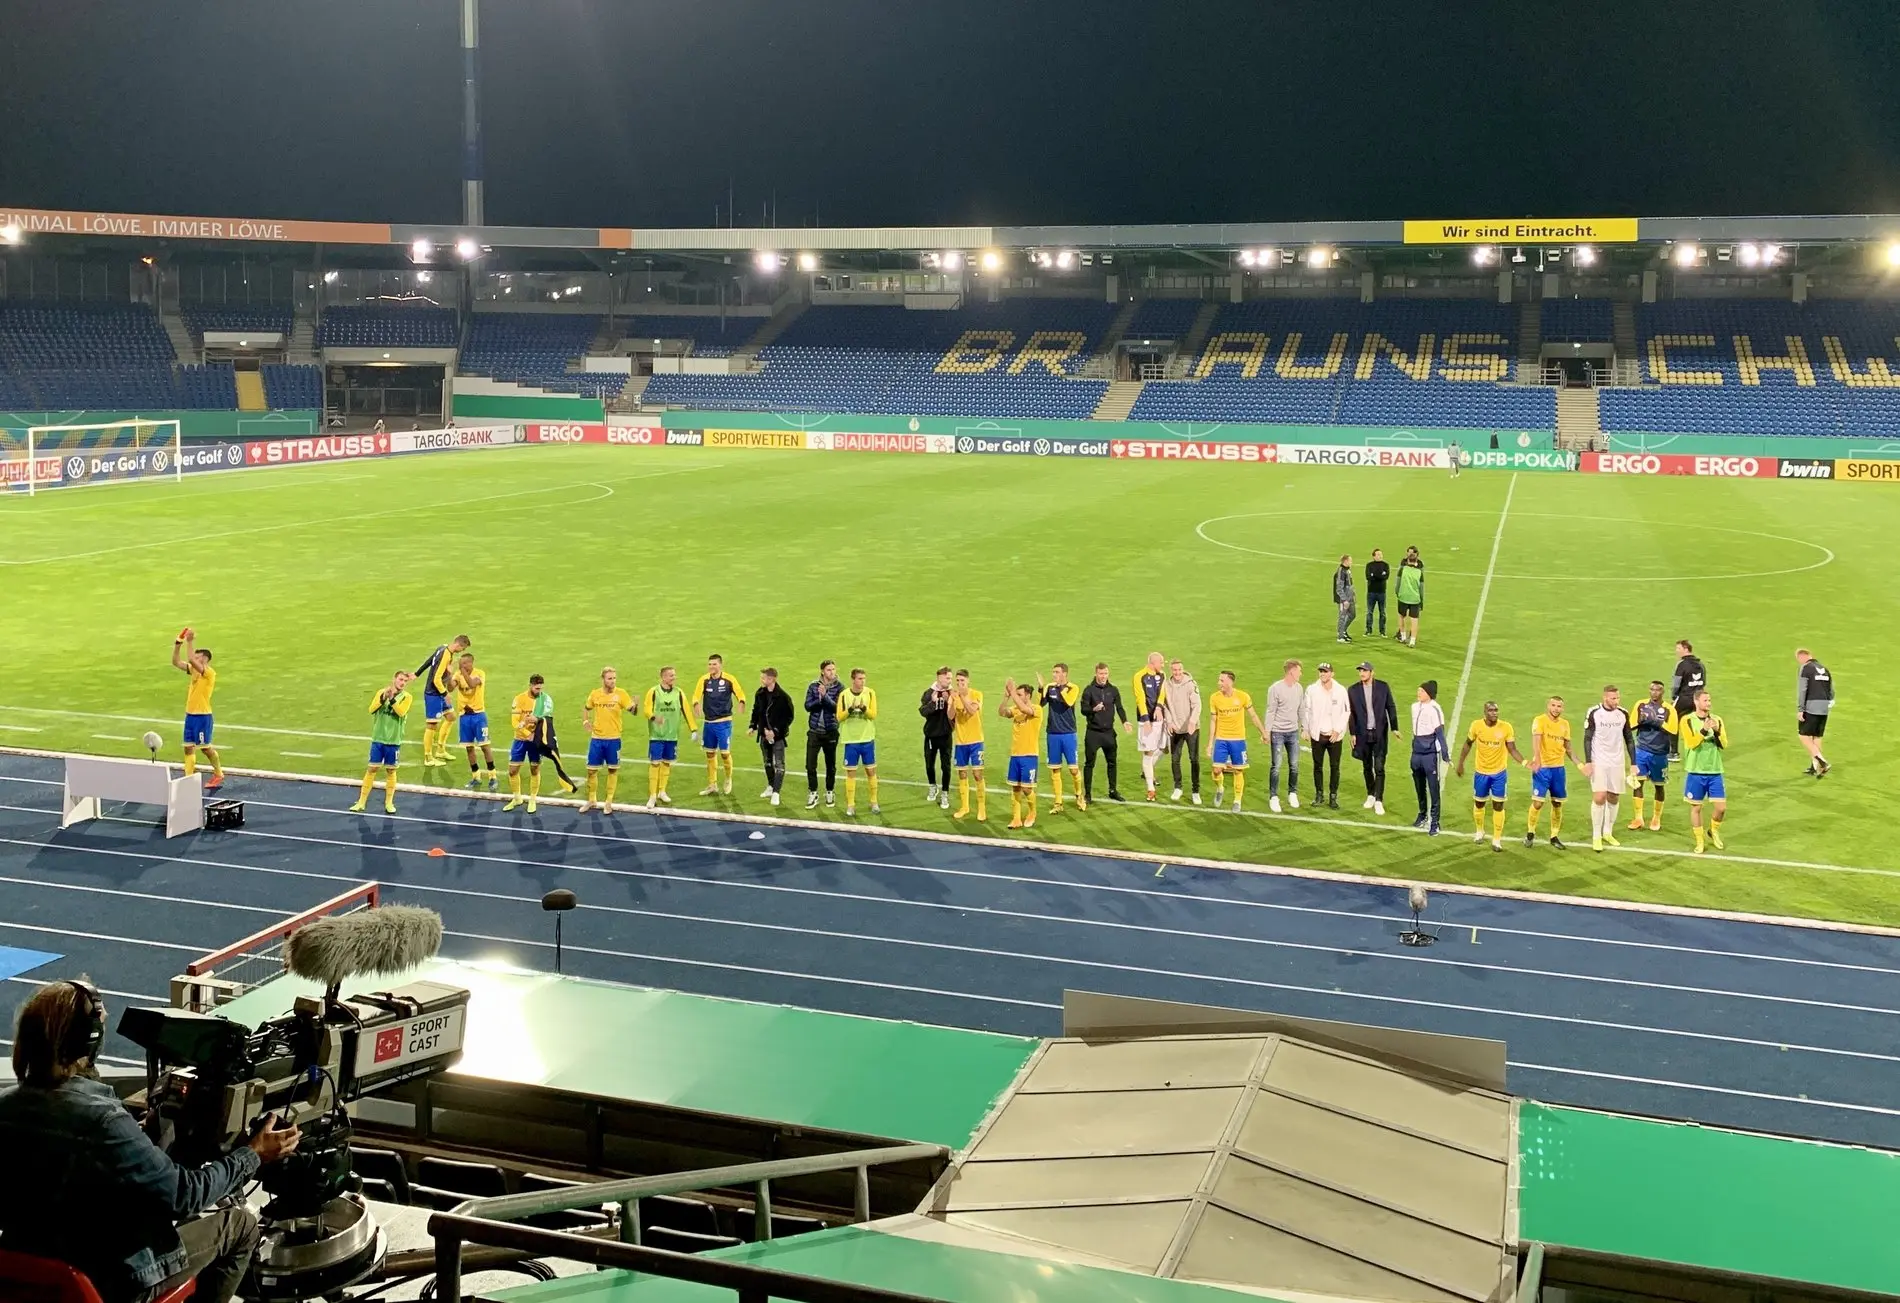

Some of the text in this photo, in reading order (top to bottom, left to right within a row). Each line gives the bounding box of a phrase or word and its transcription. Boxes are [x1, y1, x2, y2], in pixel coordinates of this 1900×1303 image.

[83, 214, 146, 234] LÖWE.
[152, 219, 222, 237] IMMER
[229, 220, 287, 239] LÖWE.
[1443, 225, 1597, 238] Wir sind Eintracht.
[539, 426, 652, 444] ERGO ERGO
[666, 430, 799, 447] bwin SPORTWETTEN
[833, 434, 927, 450] BAUHAUS
[266, 436, 375, 462] STRAUSS
[977, 440, 1000, 452] Der
[1003, 440, 1031, 453] Golf
[1053, 442, 1076, 455] Der
[1079, 442, 1108, 455] Golf
[1127, 442, 1260, 461] STRAUSS
[91, 459, 115, 473] Der
[117, 455, 146, 472] Golf
[197, 450, 222, 464] Golf
[1599, 455, 1661, 473] ERGO
[1695, 457, 1759, 476] ERGO
[1780, 461, 1831, 477] bwin
[410, 1016, 450, 1037] SPORT
[408, 1034, 440, 1054] CAST
